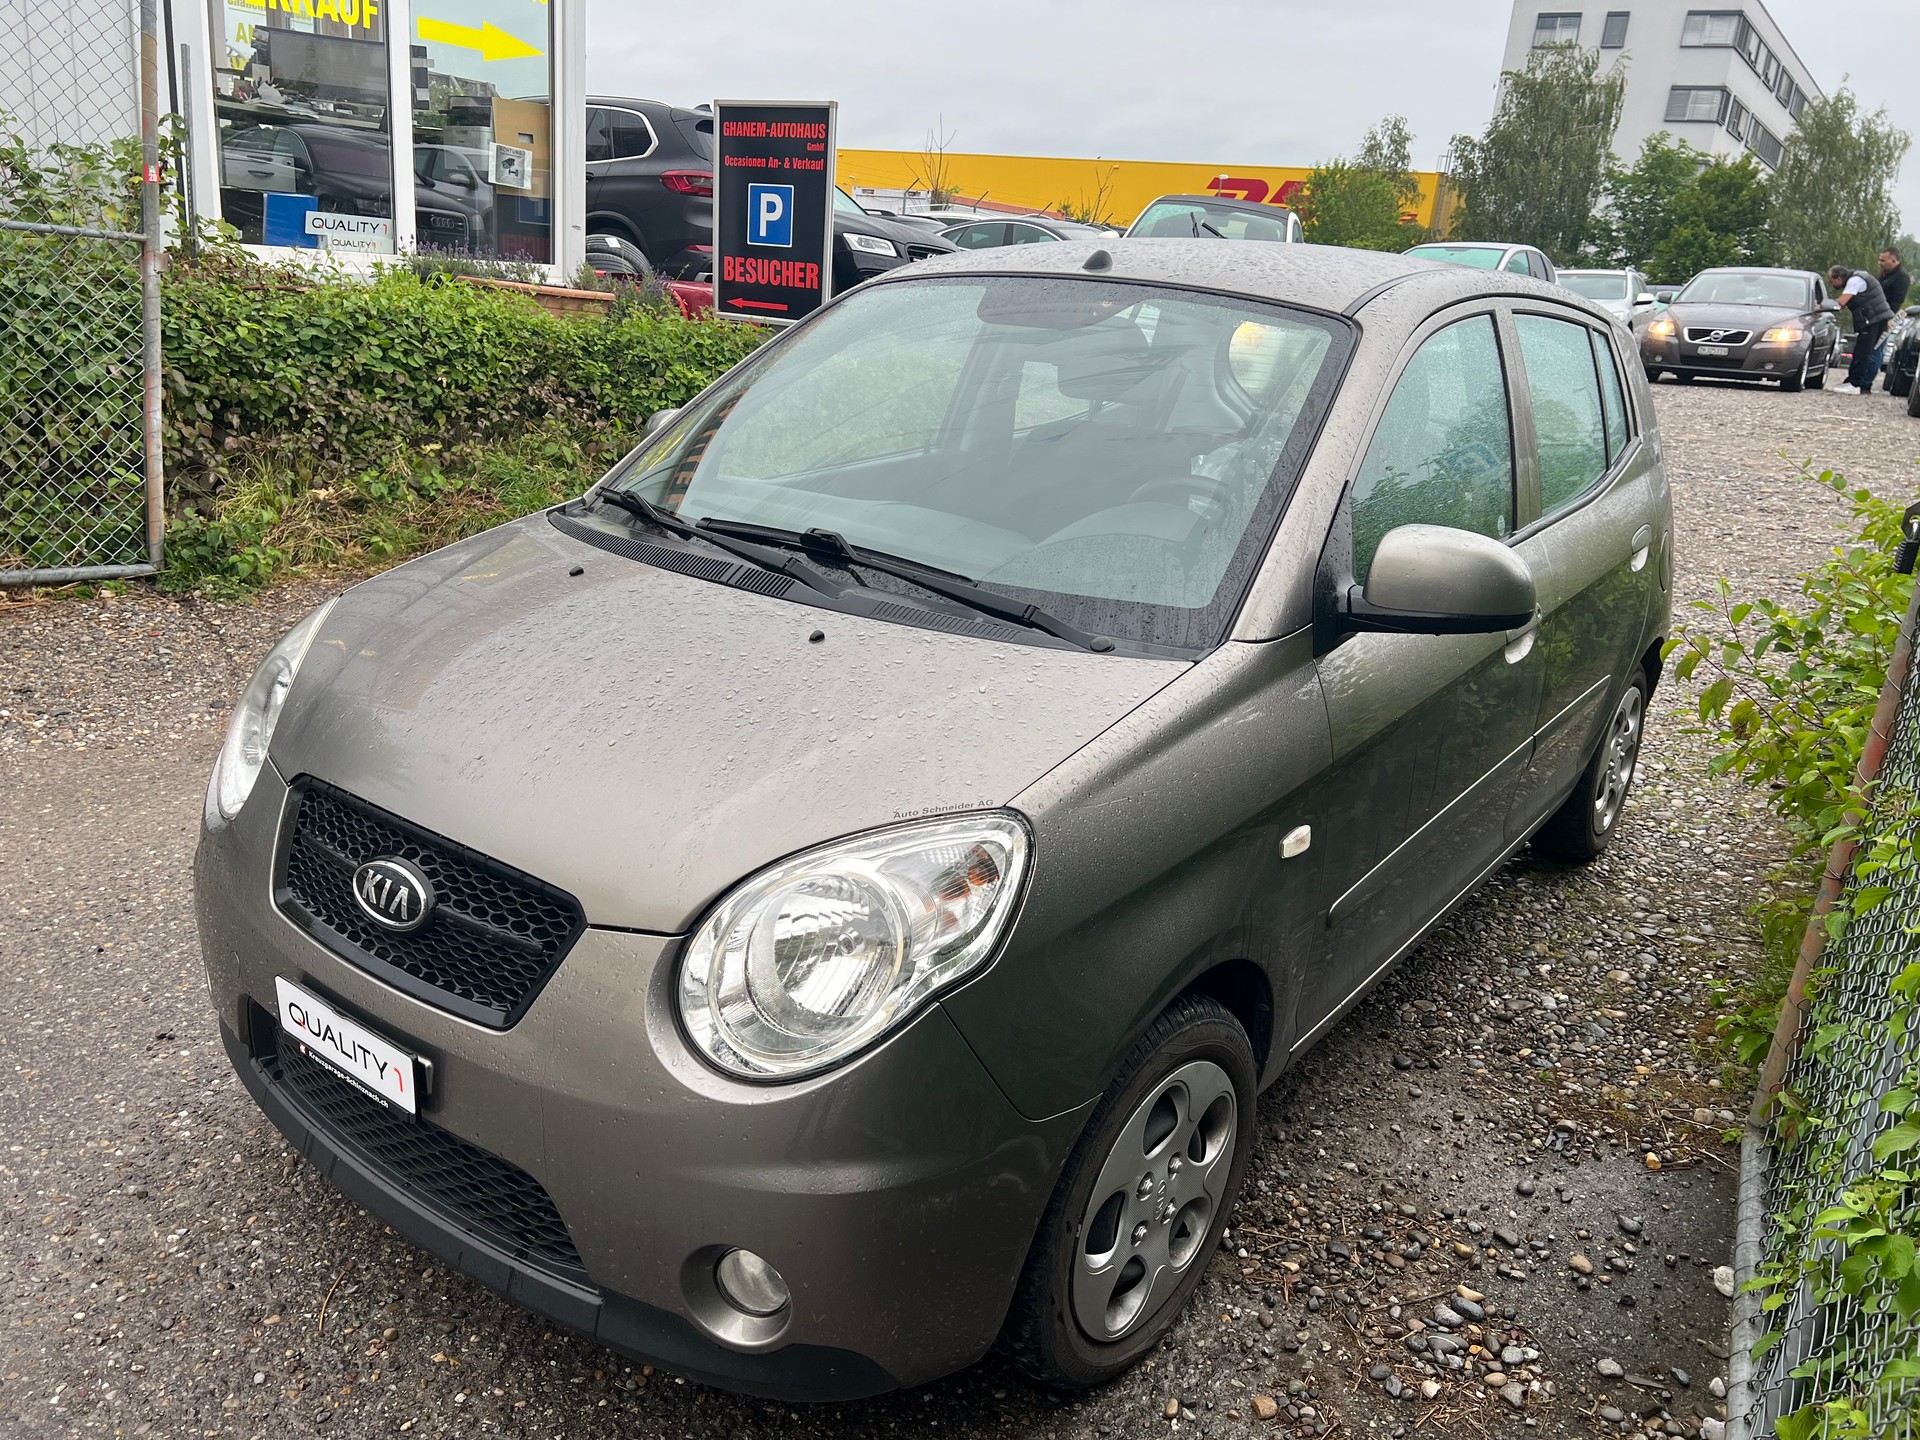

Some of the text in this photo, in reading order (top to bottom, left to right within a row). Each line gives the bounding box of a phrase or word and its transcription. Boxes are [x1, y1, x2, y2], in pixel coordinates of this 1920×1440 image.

[723, 121, 826, 139] GHANEM-AUTOHAUS
[807, 142, 825, 152] GmbH
[724, 155, 825, 170] Occasionen An- & Verkauf
[759, 193, 784, 237] P
[312, 217, 380, 234] QUALITY
[332, 238, 371, 248] QUALITY
[723, 256, 819, 289] BESUCHER
[893, 799, 994, 819] Auto Schneider AG
[361, 868, 409, 921] KIA
[288, 1002, 404, 1093] QUALITY 1
[308, 1050, 389, 1109] Kreuzgarage-Schinznach.ch
